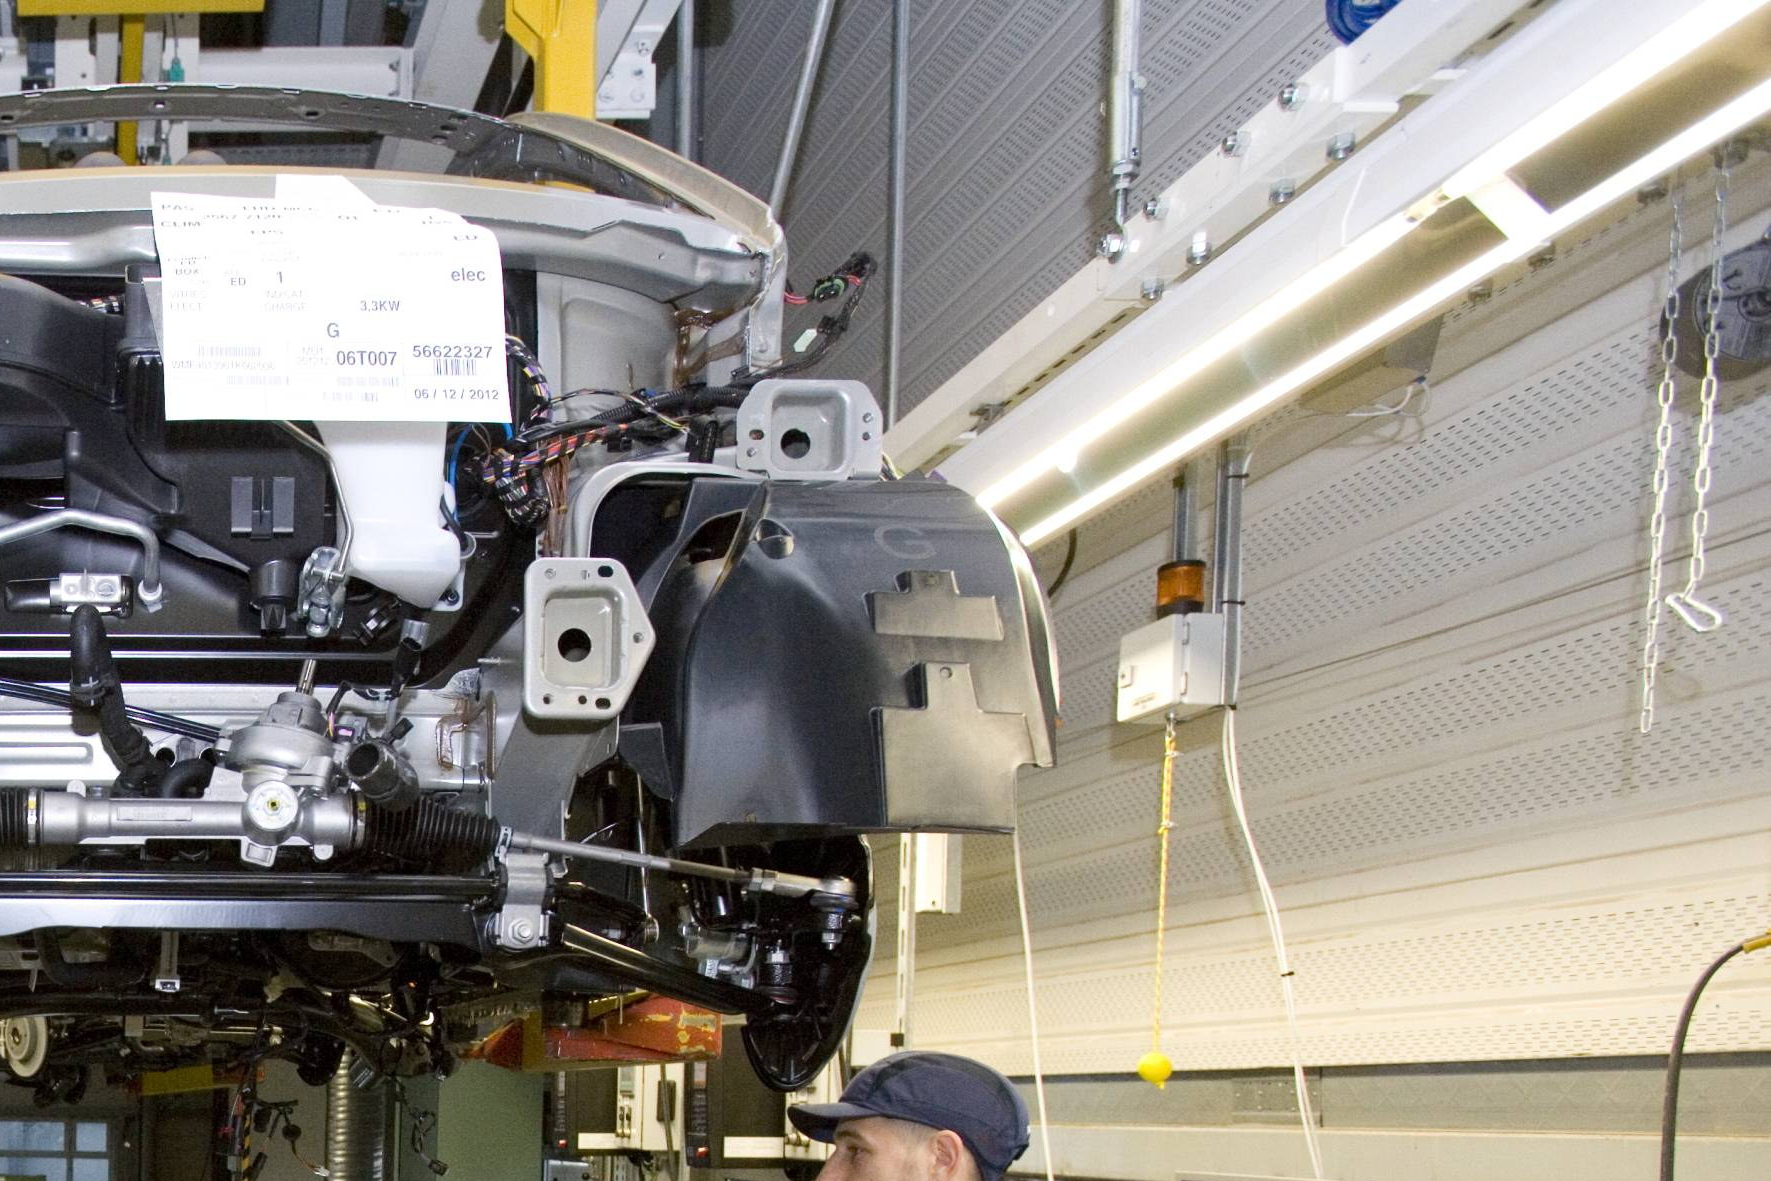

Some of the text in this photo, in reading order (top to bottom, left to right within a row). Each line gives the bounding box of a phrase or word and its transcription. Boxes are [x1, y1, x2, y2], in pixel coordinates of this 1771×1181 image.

[451, 267, 486, 281] elec
[230, 277, 246, 286] ED
[327, 322, 340, 338] G
[336, 350, 397, 366] 06T007
[412, 345, 493, 359] 56622327
[414, 388, 429, 400] 06
[442, 389, 457, 400] 12
[469, 389, 499, 400] 2012
[874, 525, 937, 560] G
